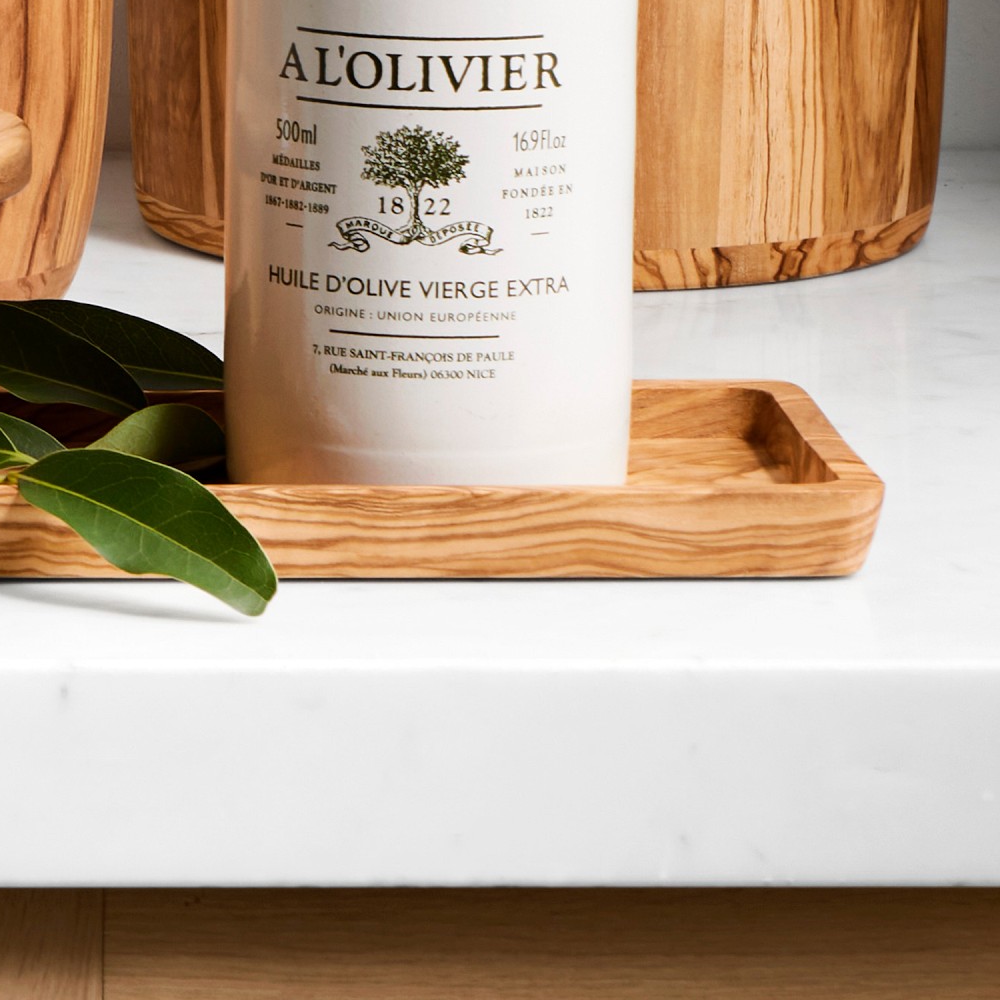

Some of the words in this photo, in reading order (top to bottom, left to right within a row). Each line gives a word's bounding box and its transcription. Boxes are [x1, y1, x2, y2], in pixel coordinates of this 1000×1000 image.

[276, 118, 317, 145] 500ml
[272, 153, 321, 171] MÉDAILLES
[513, 164, 567, 178] MAISON
[260, 171, 277, 186] D'OR
[279, 176, 290, 188] ET
[291, 178, 338, 194] D'ARGENT
[501, 185, 555, 199] FONDÉE
[558, 183, 573, 195] EN
[378, 196, 405, 215] 18
[424, 197, 452, 216] 22
[525, 206, 554, 219] 1822
[345, 219, 394, 240] MARQUE
[268, 265, 320, 291] HUILE
[325, 274, 412, 299] D'OLIVE
[419, 280, 500, 299] VIERGE
[507, 276, 569, 297] EXTRA
[314, 304, 365, 320] ORIGINE
[377, 311, 424, 322] UNION
[429, 310, 517, 322] EUROPÉENNE
[312, 344, 322, 355] 7,
[323, 345, 348, 358] RUE
[349, 348, 454, 364] SAINT-FRANÇOIS
[456, 351, 473, 363] DE
[475, 350, 515, 362] PAULE
[329, 363, 369, 377] (Marché
[371, 369, 389, 378] aux
[391, 368, 428, 380] Fleurs)
[430, 369, 464, 380] 06300
[466, 369, 496, 380] NICE
